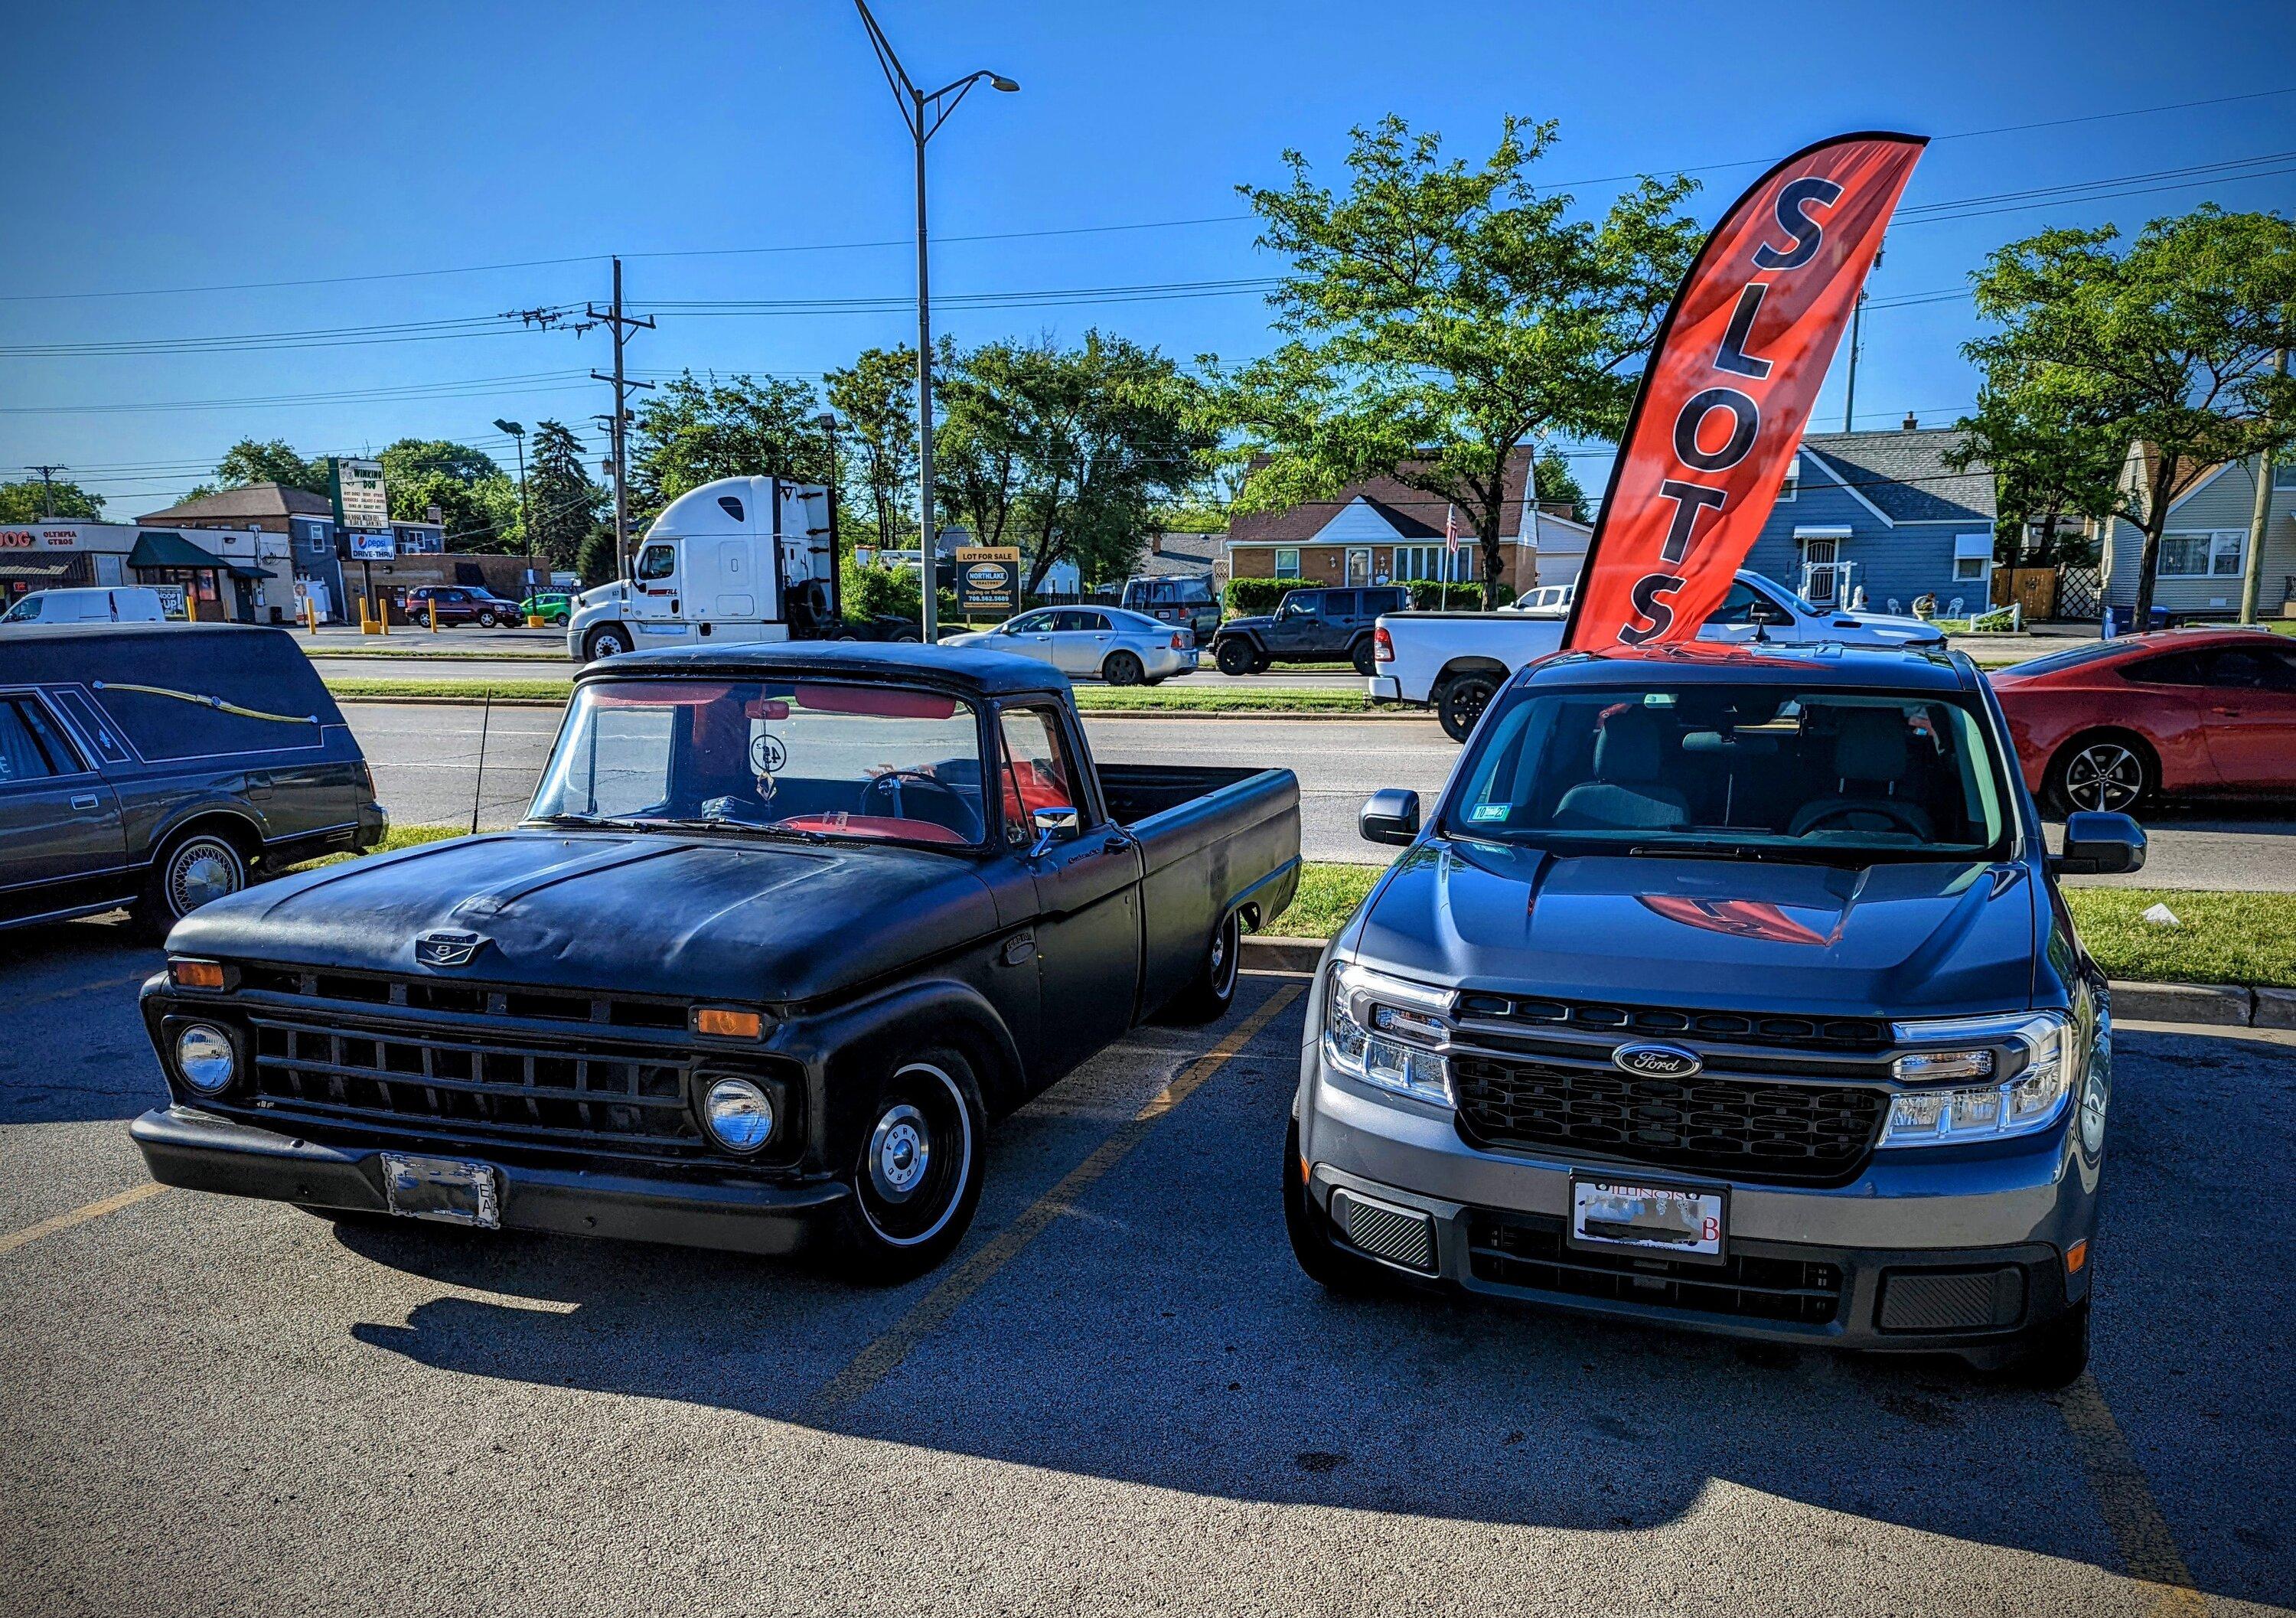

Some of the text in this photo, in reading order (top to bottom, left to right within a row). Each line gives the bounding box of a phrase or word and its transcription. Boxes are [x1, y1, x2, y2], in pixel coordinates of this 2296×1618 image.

[1618, 177, 1844, 644] SLOTS
[354, 468, 382, 480] WINKING
[363, 480, 377, 490] DOG
[367, 539, 386, 549] pepsi
[1476, 807, 1487, 818] 10
[1494, 807, 1505, 818] 23
[1006, 935, 1022, 951] FORD
[1634, 1052, 1680, 1072] Ford
[885, 1127, 916, 1151] FORD
[1701, 1216, 1720, 1241] B
